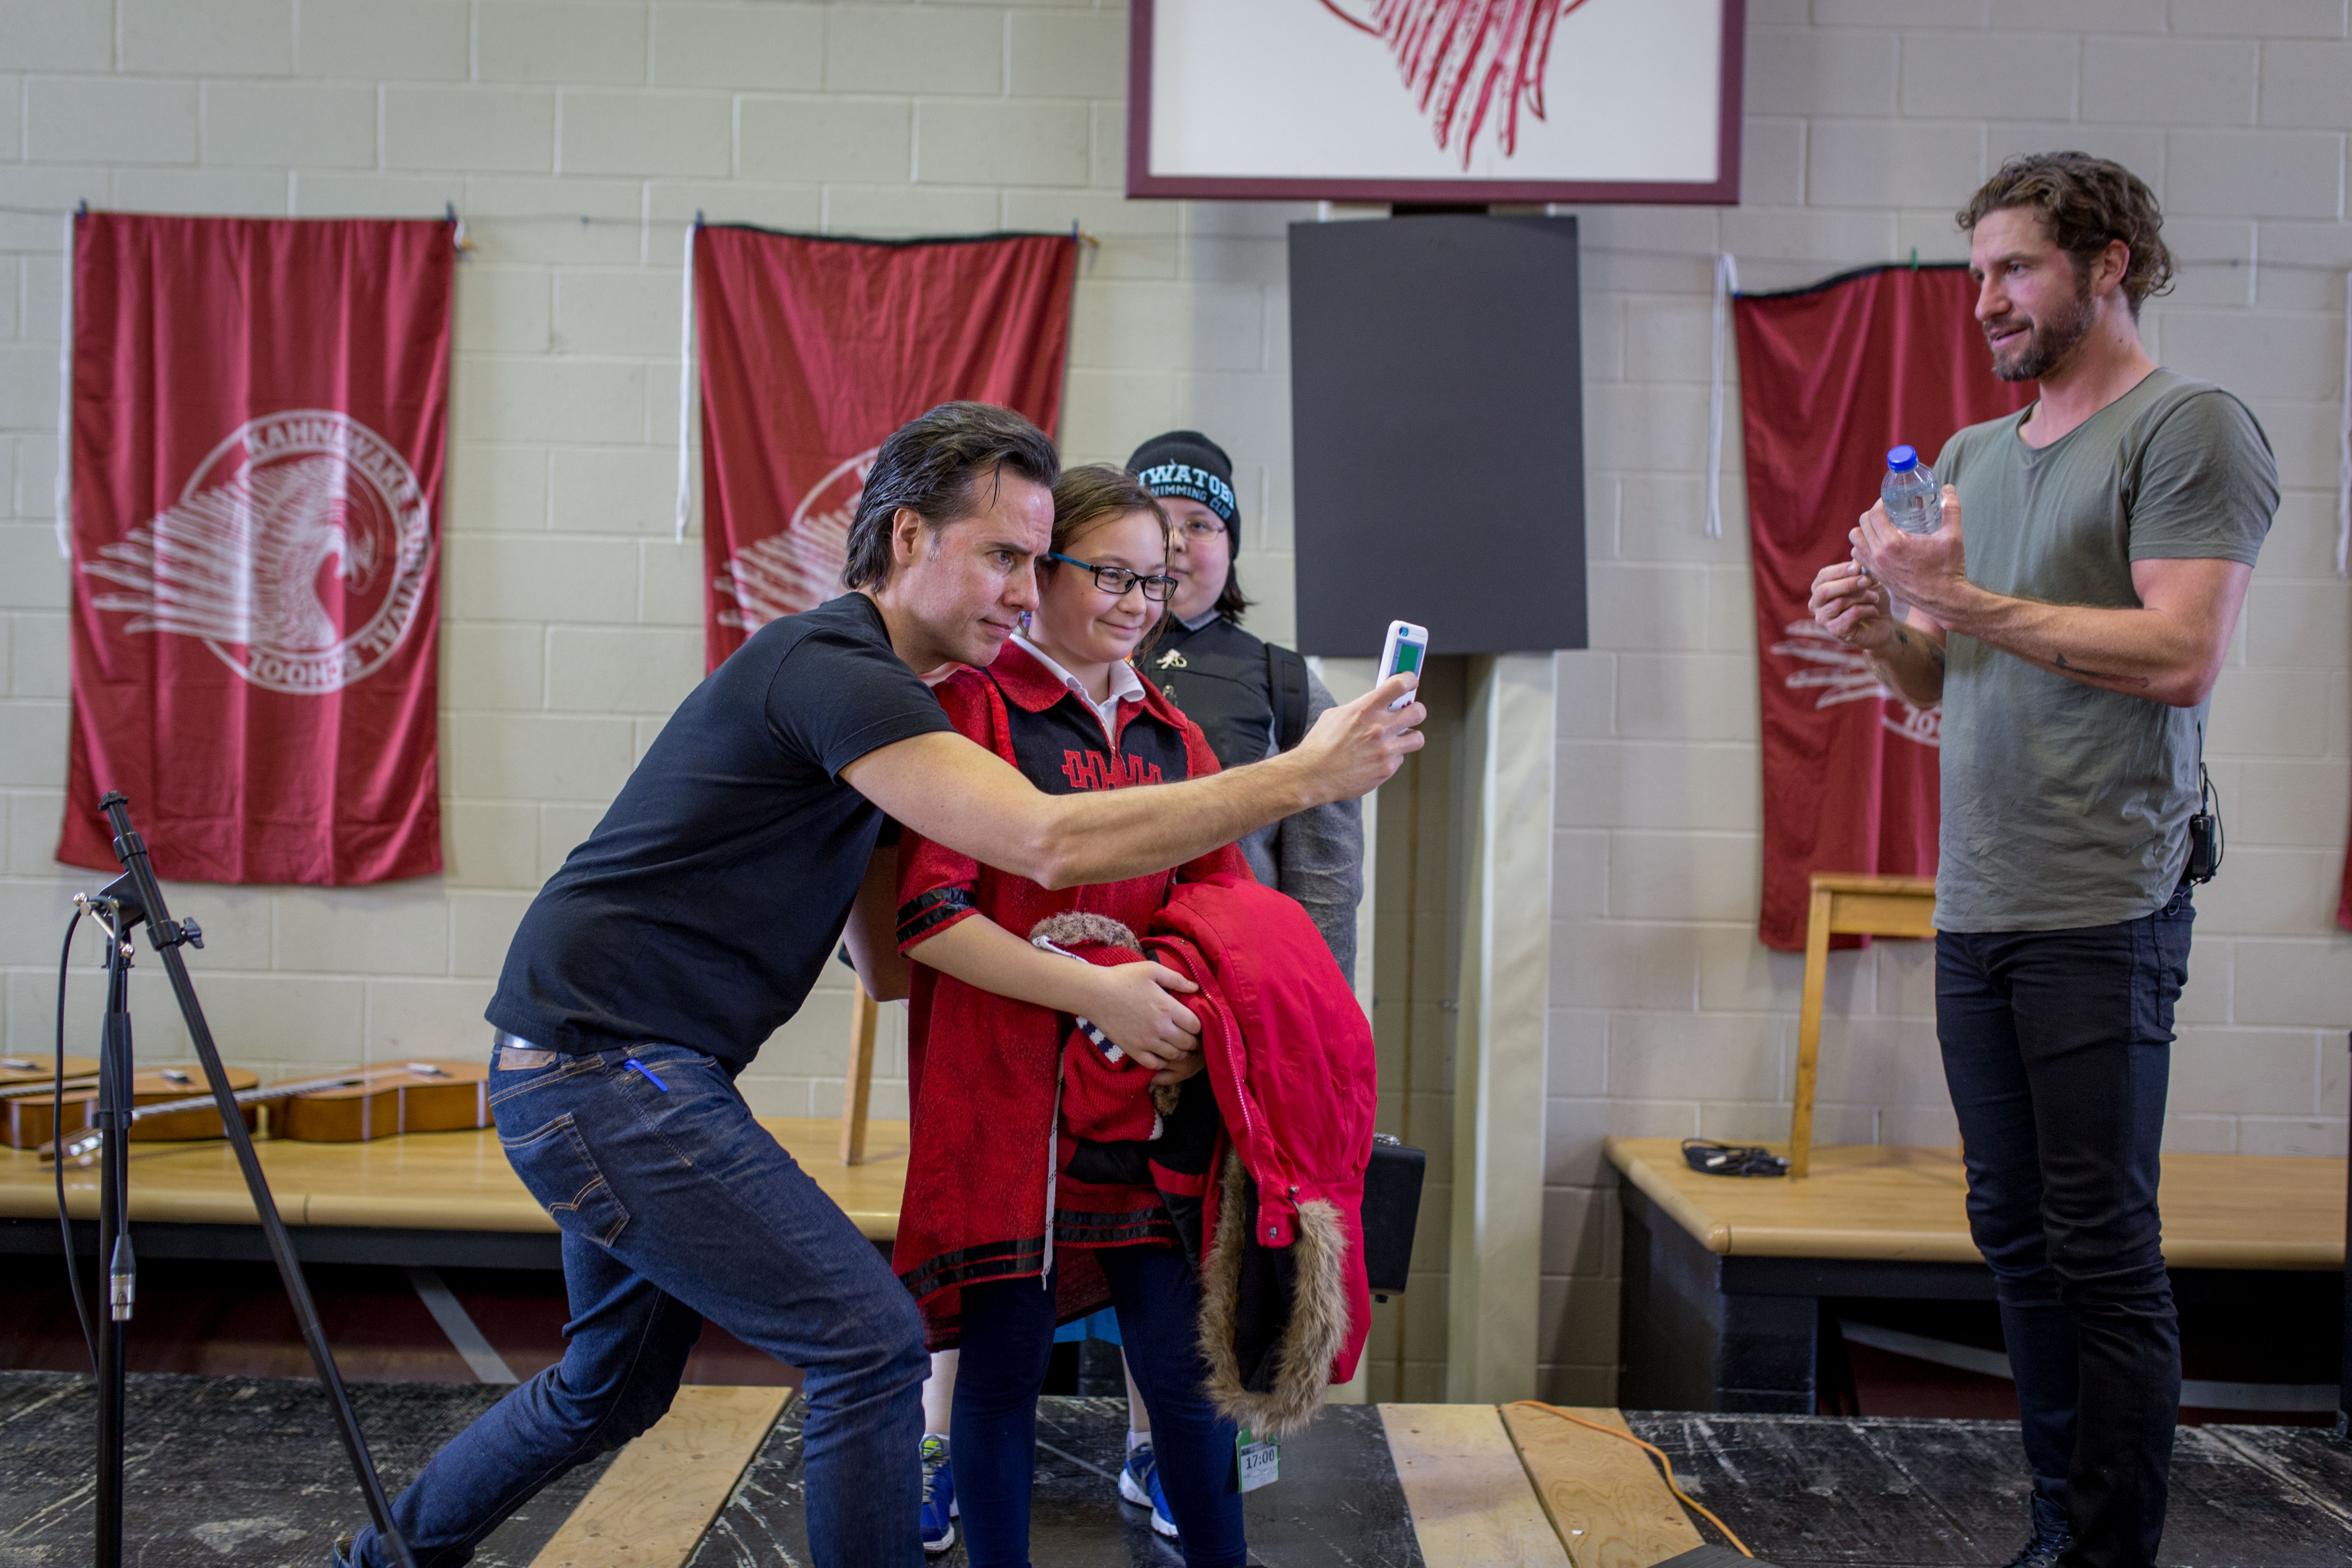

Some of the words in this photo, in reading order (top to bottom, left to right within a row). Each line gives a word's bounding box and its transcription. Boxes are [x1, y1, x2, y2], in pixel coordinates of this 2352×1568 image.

[1150, 484, 1207, 502] WIMMING
[246, 646, 362, 684] SCHOOL
[1246, 1449, 1274, 1470] 17:00
